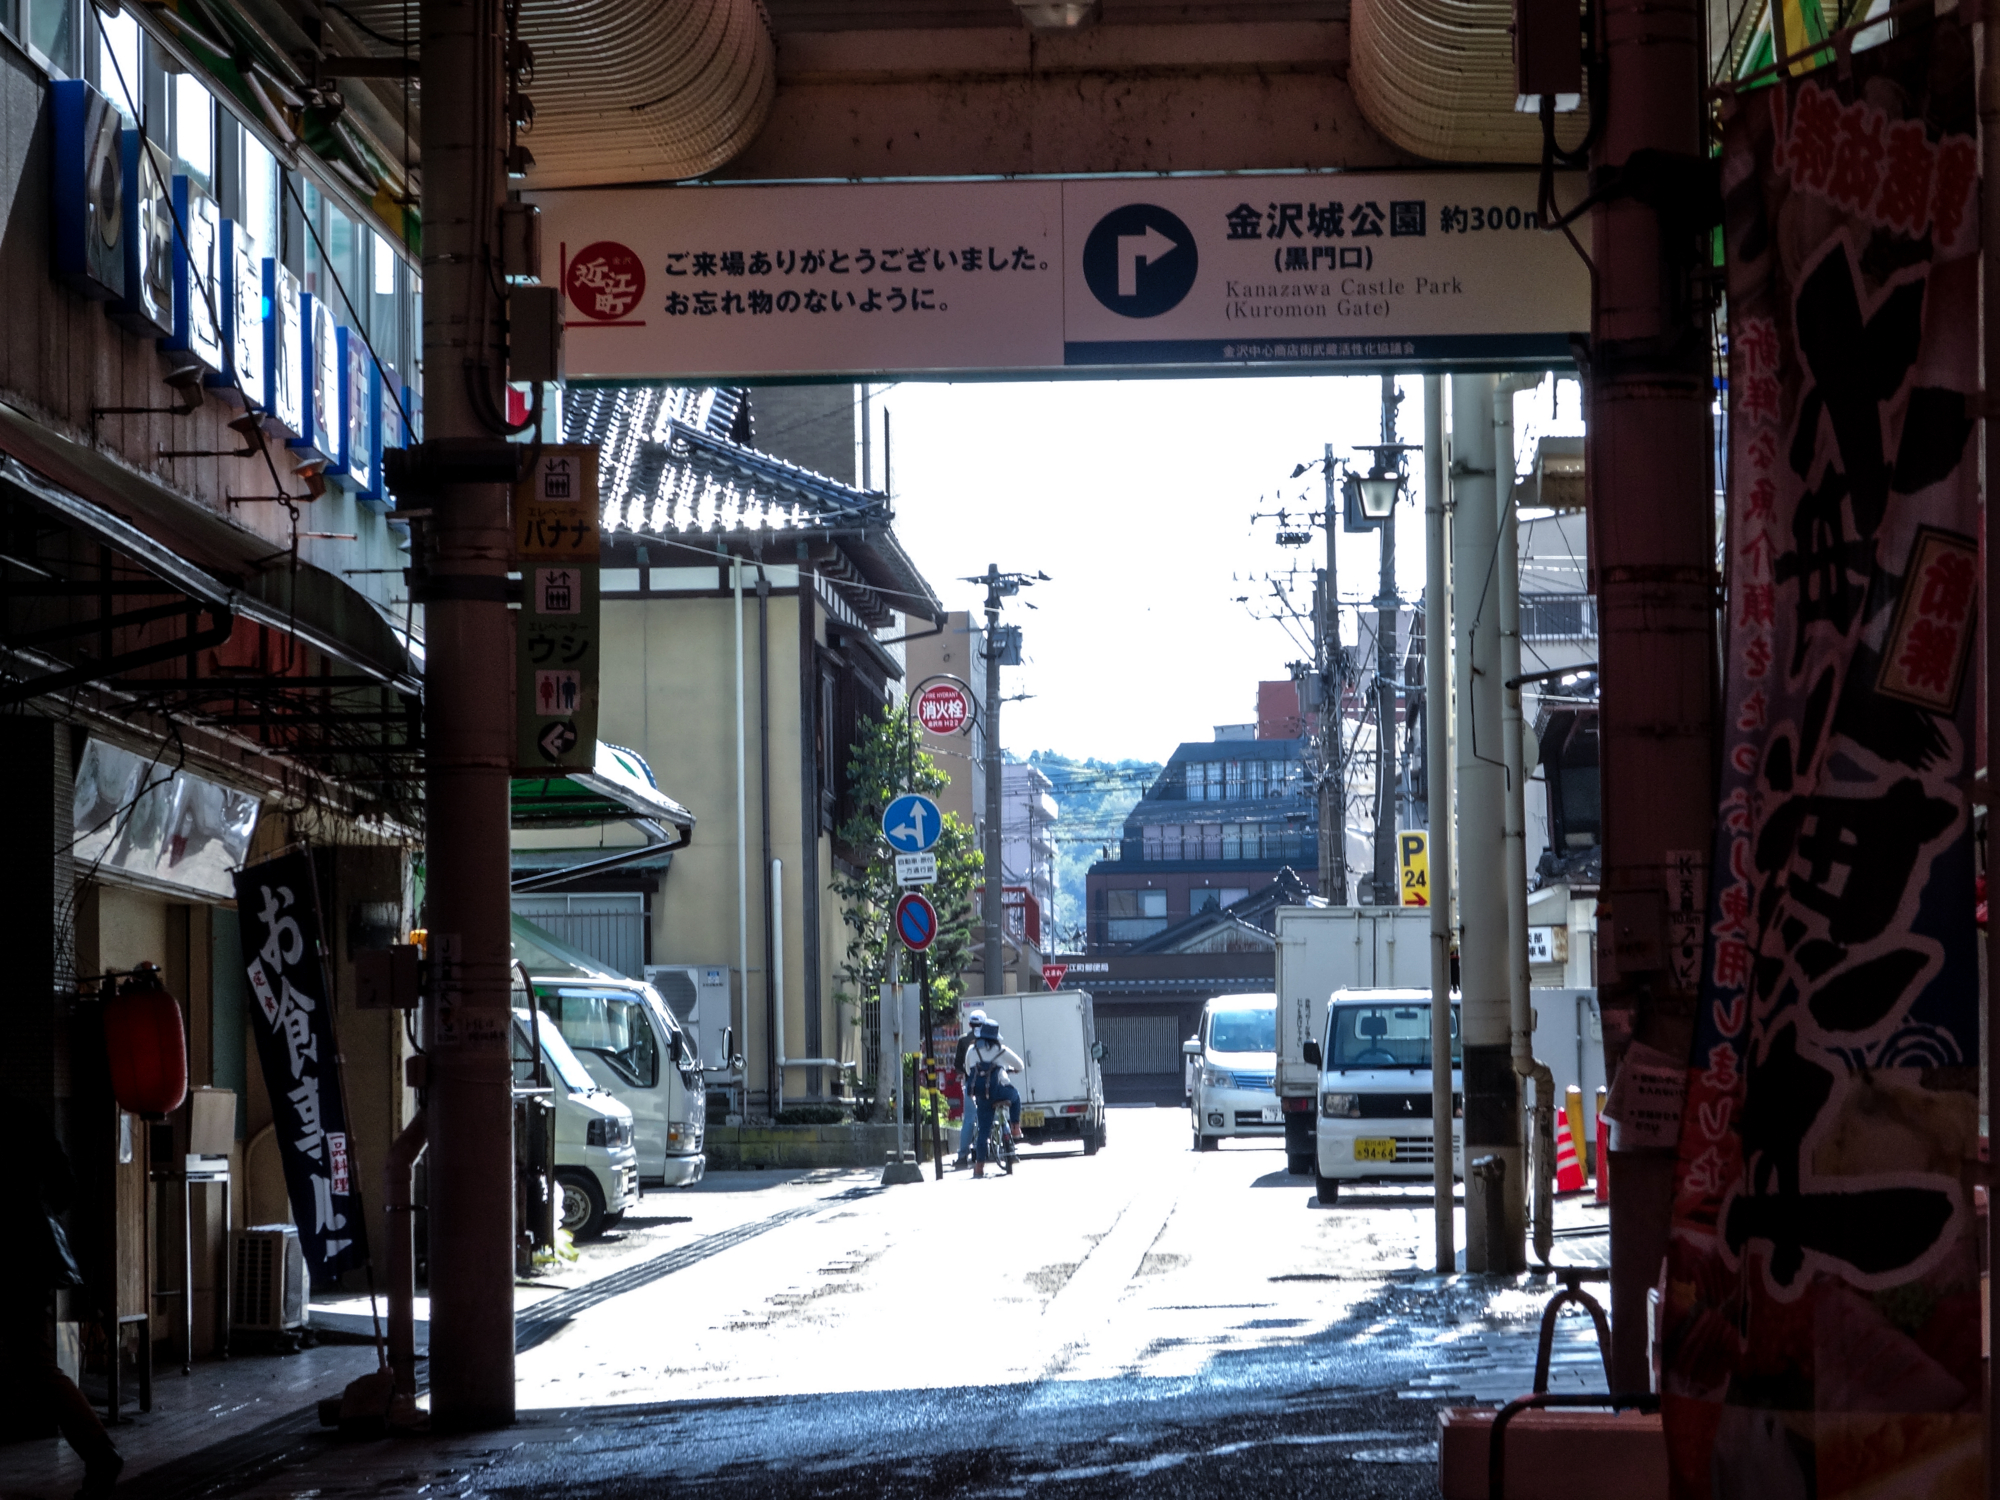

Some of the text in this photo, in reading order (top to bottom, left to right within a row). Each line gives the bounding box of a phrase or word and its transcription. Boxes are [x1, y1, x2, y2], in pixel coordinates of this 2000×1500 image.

[1226, 201, 1427, 240] 金沢城公園
[612, 256, 633, 266] 金沢
[665, 246, 1049, 277] ご来場ありがとうございました。
[1275, 246, 1374, 271] (黒門口)
[573, 257, 638, 315] 近江町
[1225, 275, 1463, 298] Kanazawa Castle Park
[665, 287, 949, 316] お忘れ物のないように。
[1225, 298, 1390, 320] (Kuromon Gate)
[527, 507, 588, 518] エレベーター
[524, 520, 591, 548] バナナ
[528, 622, 589, 632] エレベーター
[528, 634, 589, 664] ウシ
[925, 691, 936, 699] FIRE
[922, 699, 963, 720] 消火栓
[1402, 835, 1425, 867] P
[1404, 870, 1427, 888] 24
[1067, 963, 1109, 973] 江町郵便局
[328, 1133, 350, 1195] 一品料理
